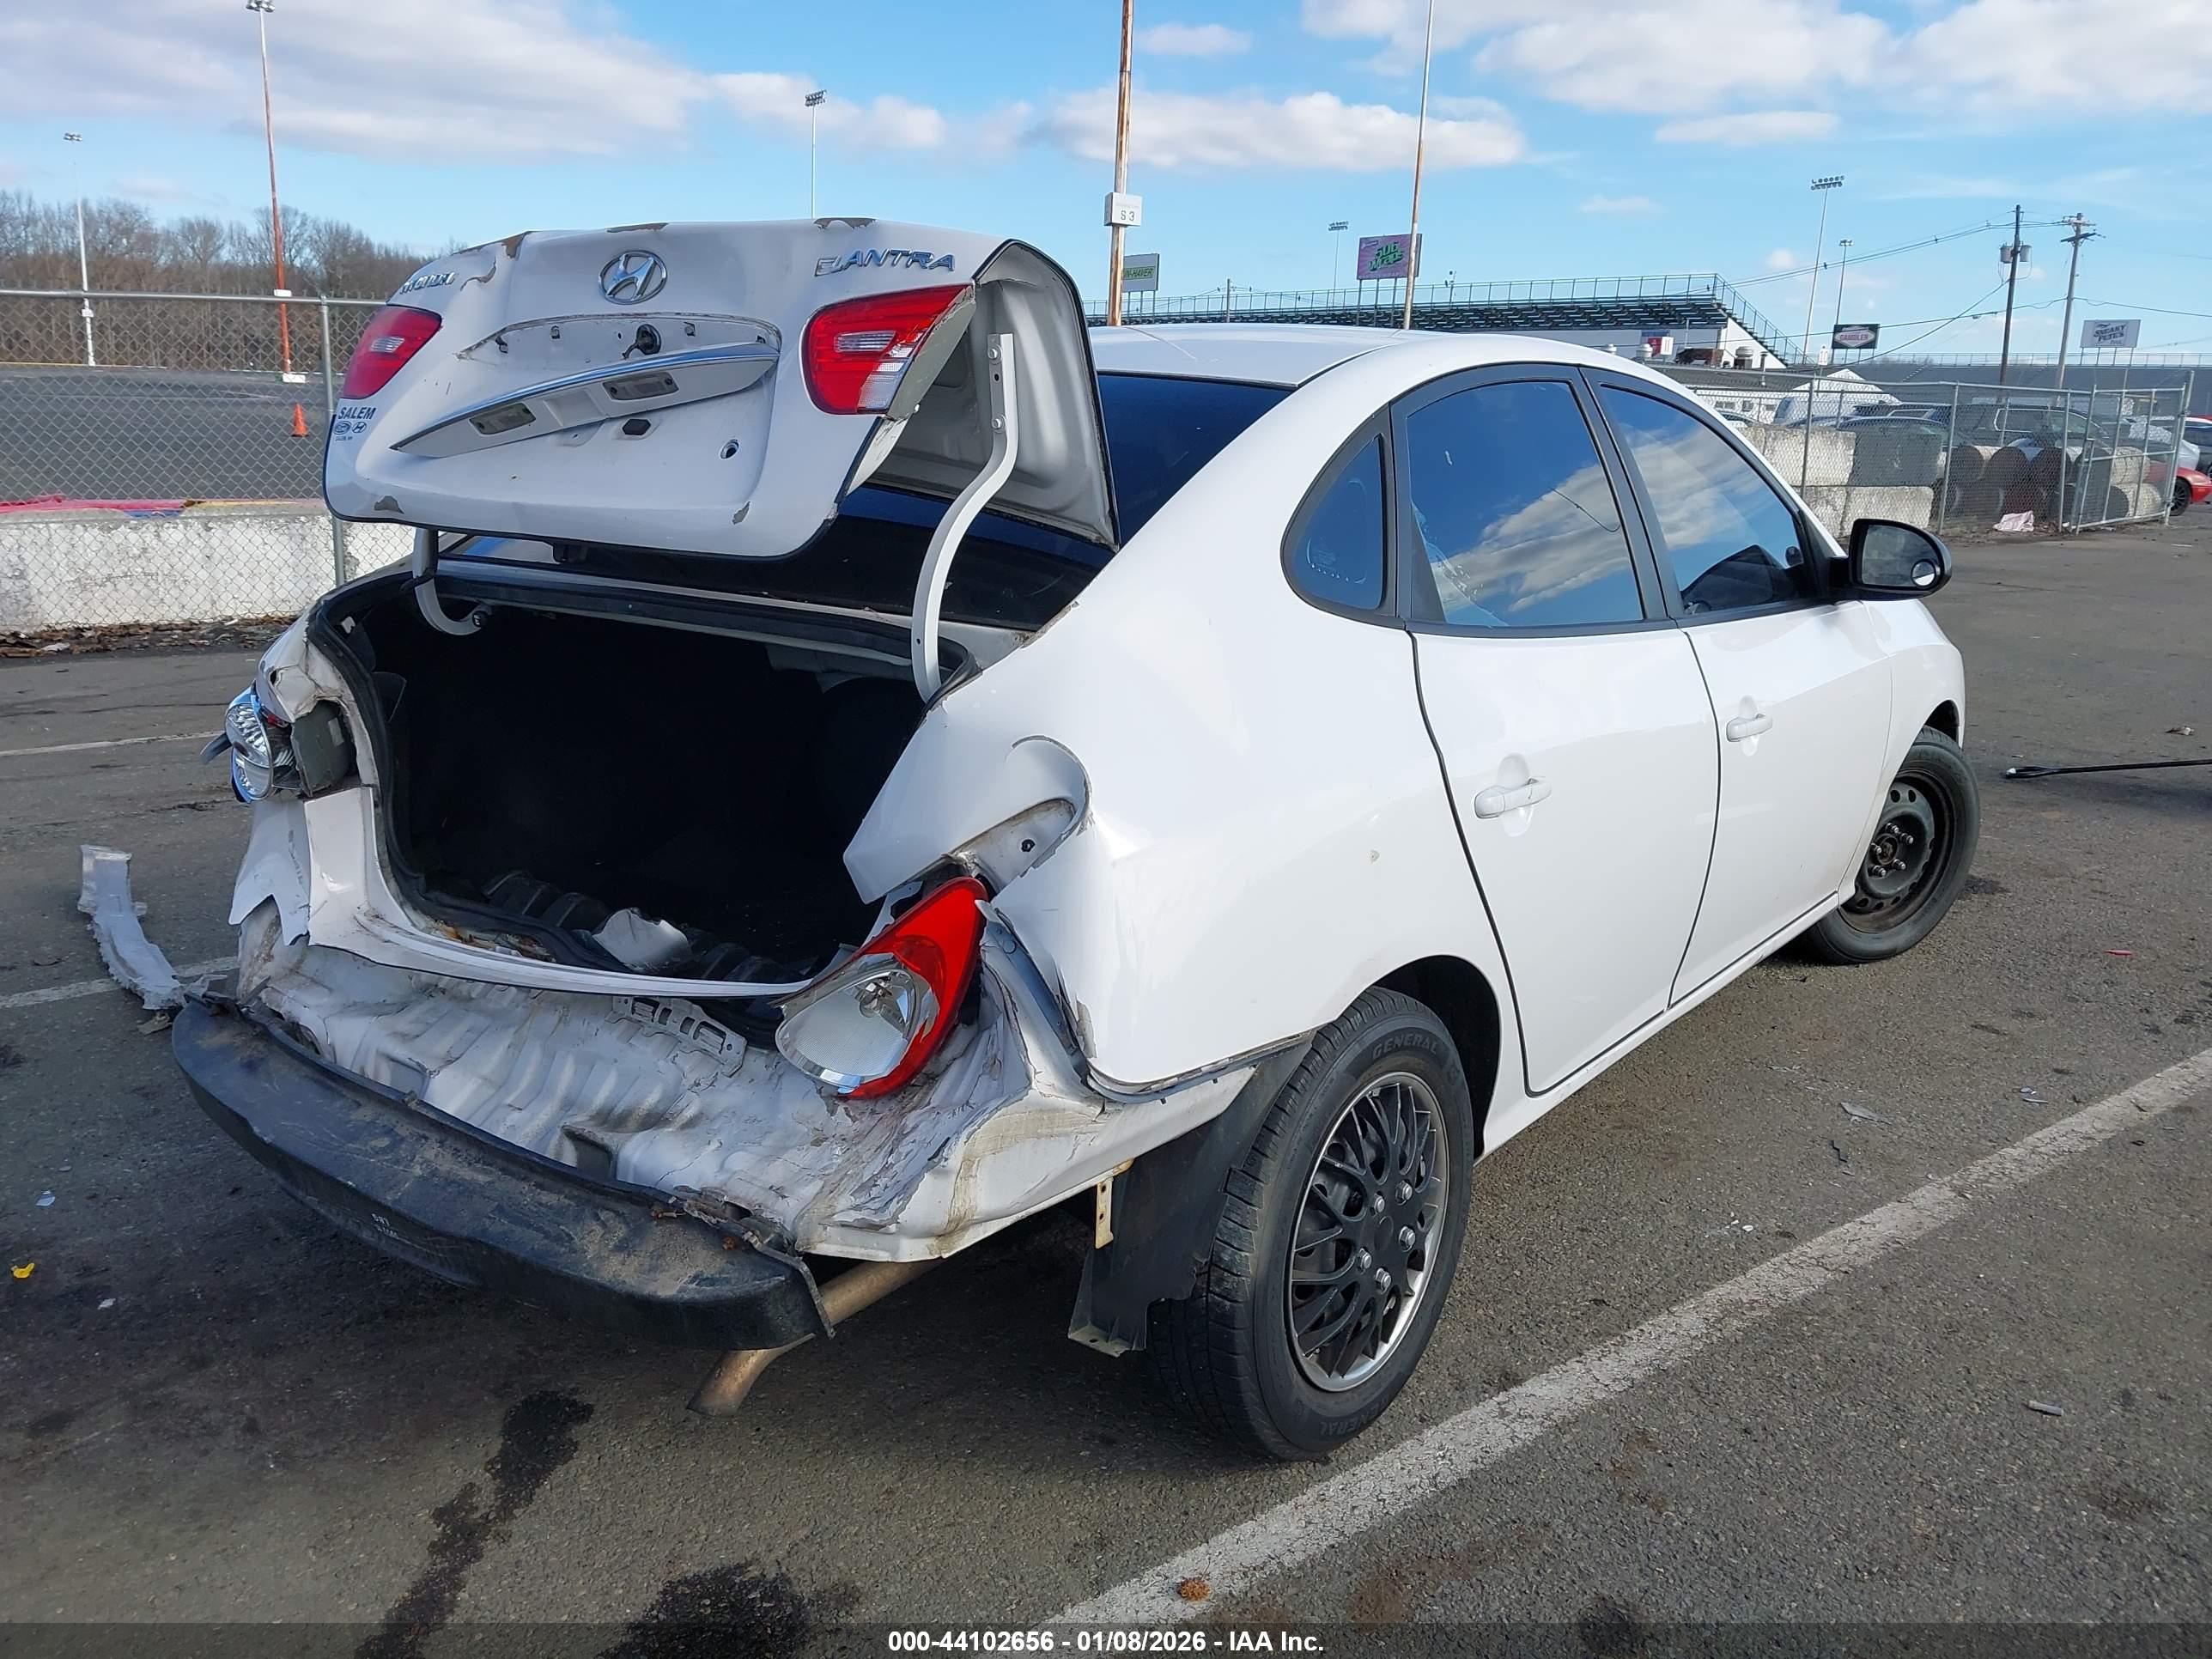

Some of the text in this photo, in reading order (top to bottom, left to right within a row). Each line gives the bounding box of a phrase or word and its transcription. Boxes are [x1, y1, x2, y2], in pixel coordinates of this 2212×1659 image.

[815, 248, 956, 276] ELANTRA
[337, 407, 376, 420] SALEM
[1373, 1032, 1437, 1059] GENERAL
